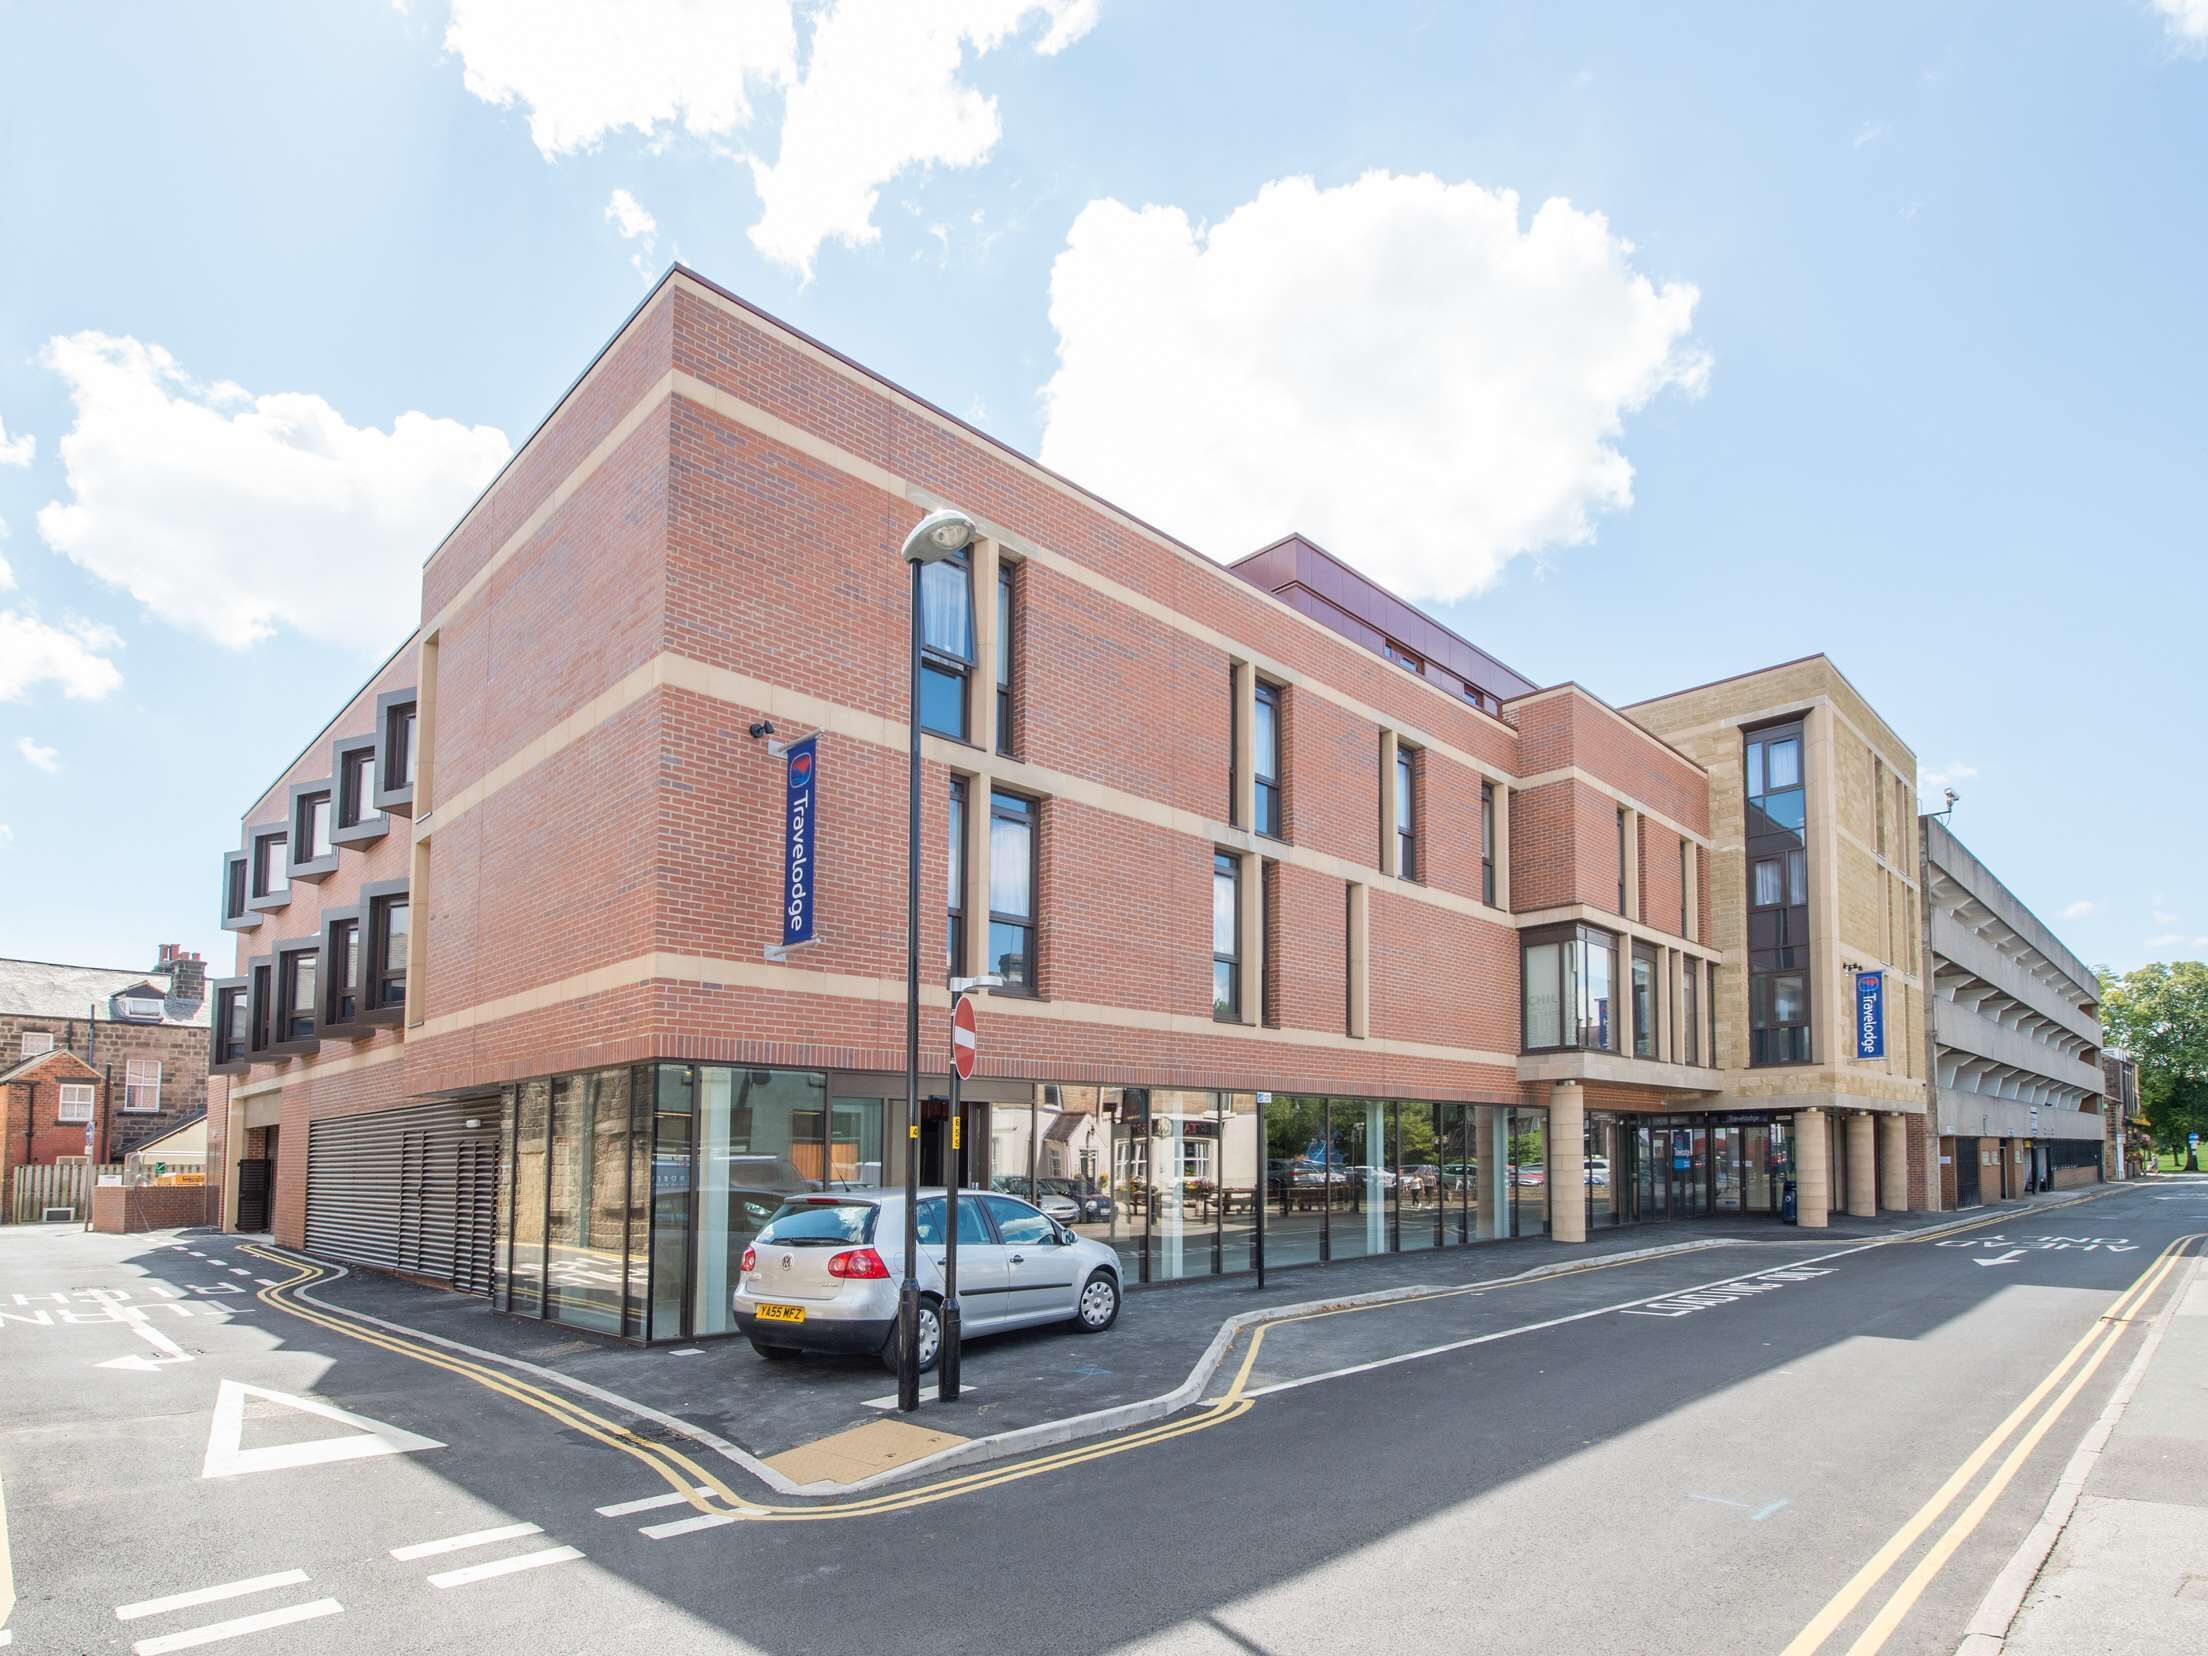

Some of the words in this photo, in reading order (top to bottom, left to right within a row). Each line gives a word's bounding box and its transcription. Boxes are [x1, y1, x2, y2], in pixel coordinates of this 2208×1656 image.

[789, 789, 808, 931] Travelodge
[1861, 992, 1878, 1053] Travelodge
[1935, 1240, 2140, 1252] AHEAD
[0, 1282, 246, 1306] RIGH
[1619, 1282, 1783, 1317] LOADING
[1756, 1266, 1840, 1281] ONLY
[761, 1304, 782, 1318] YA55
[783, 1306, 802, 1320] MFZ
